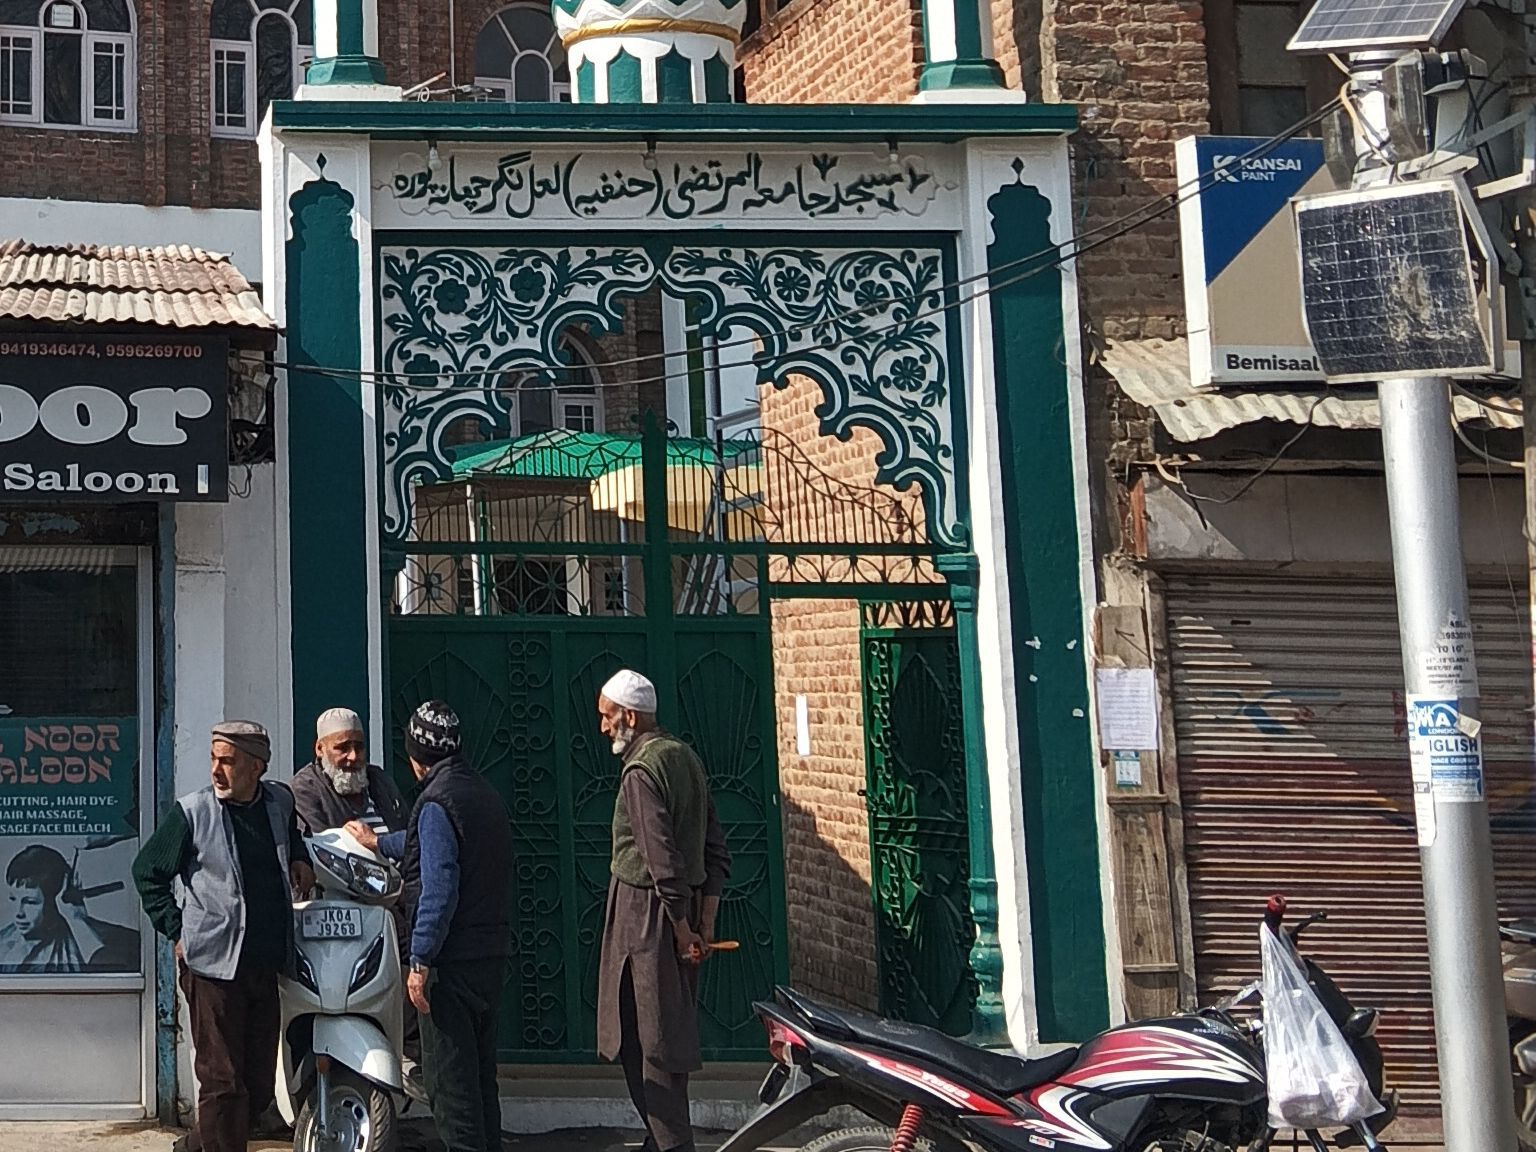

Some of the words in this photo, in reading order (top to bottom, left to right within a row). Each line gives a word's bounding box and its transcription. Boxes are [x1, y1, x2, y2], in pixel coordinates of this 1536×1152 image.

[1241, 158, 1302, 170] KANSAI
[1241, 171, 1277, 181] PAINT
[0, 342, 101, 359] 9419346474,
[105, 344, 202, 358] 9596269700
[1226, 353, 1320, 371] Bemisaal
[4, 462, 180, 494] Saloon
[24, 724, 121, 753] NOOR
[57, 796, 87, 807] HAIR
[26, 810, 87, 821] MASSAGE,
[32, 824, 62, 834] FACE
[63, 823, 111, 833] BLEACH
[321, 910, 352, 923] JK04
[318, 923, 356, 936] J9268
